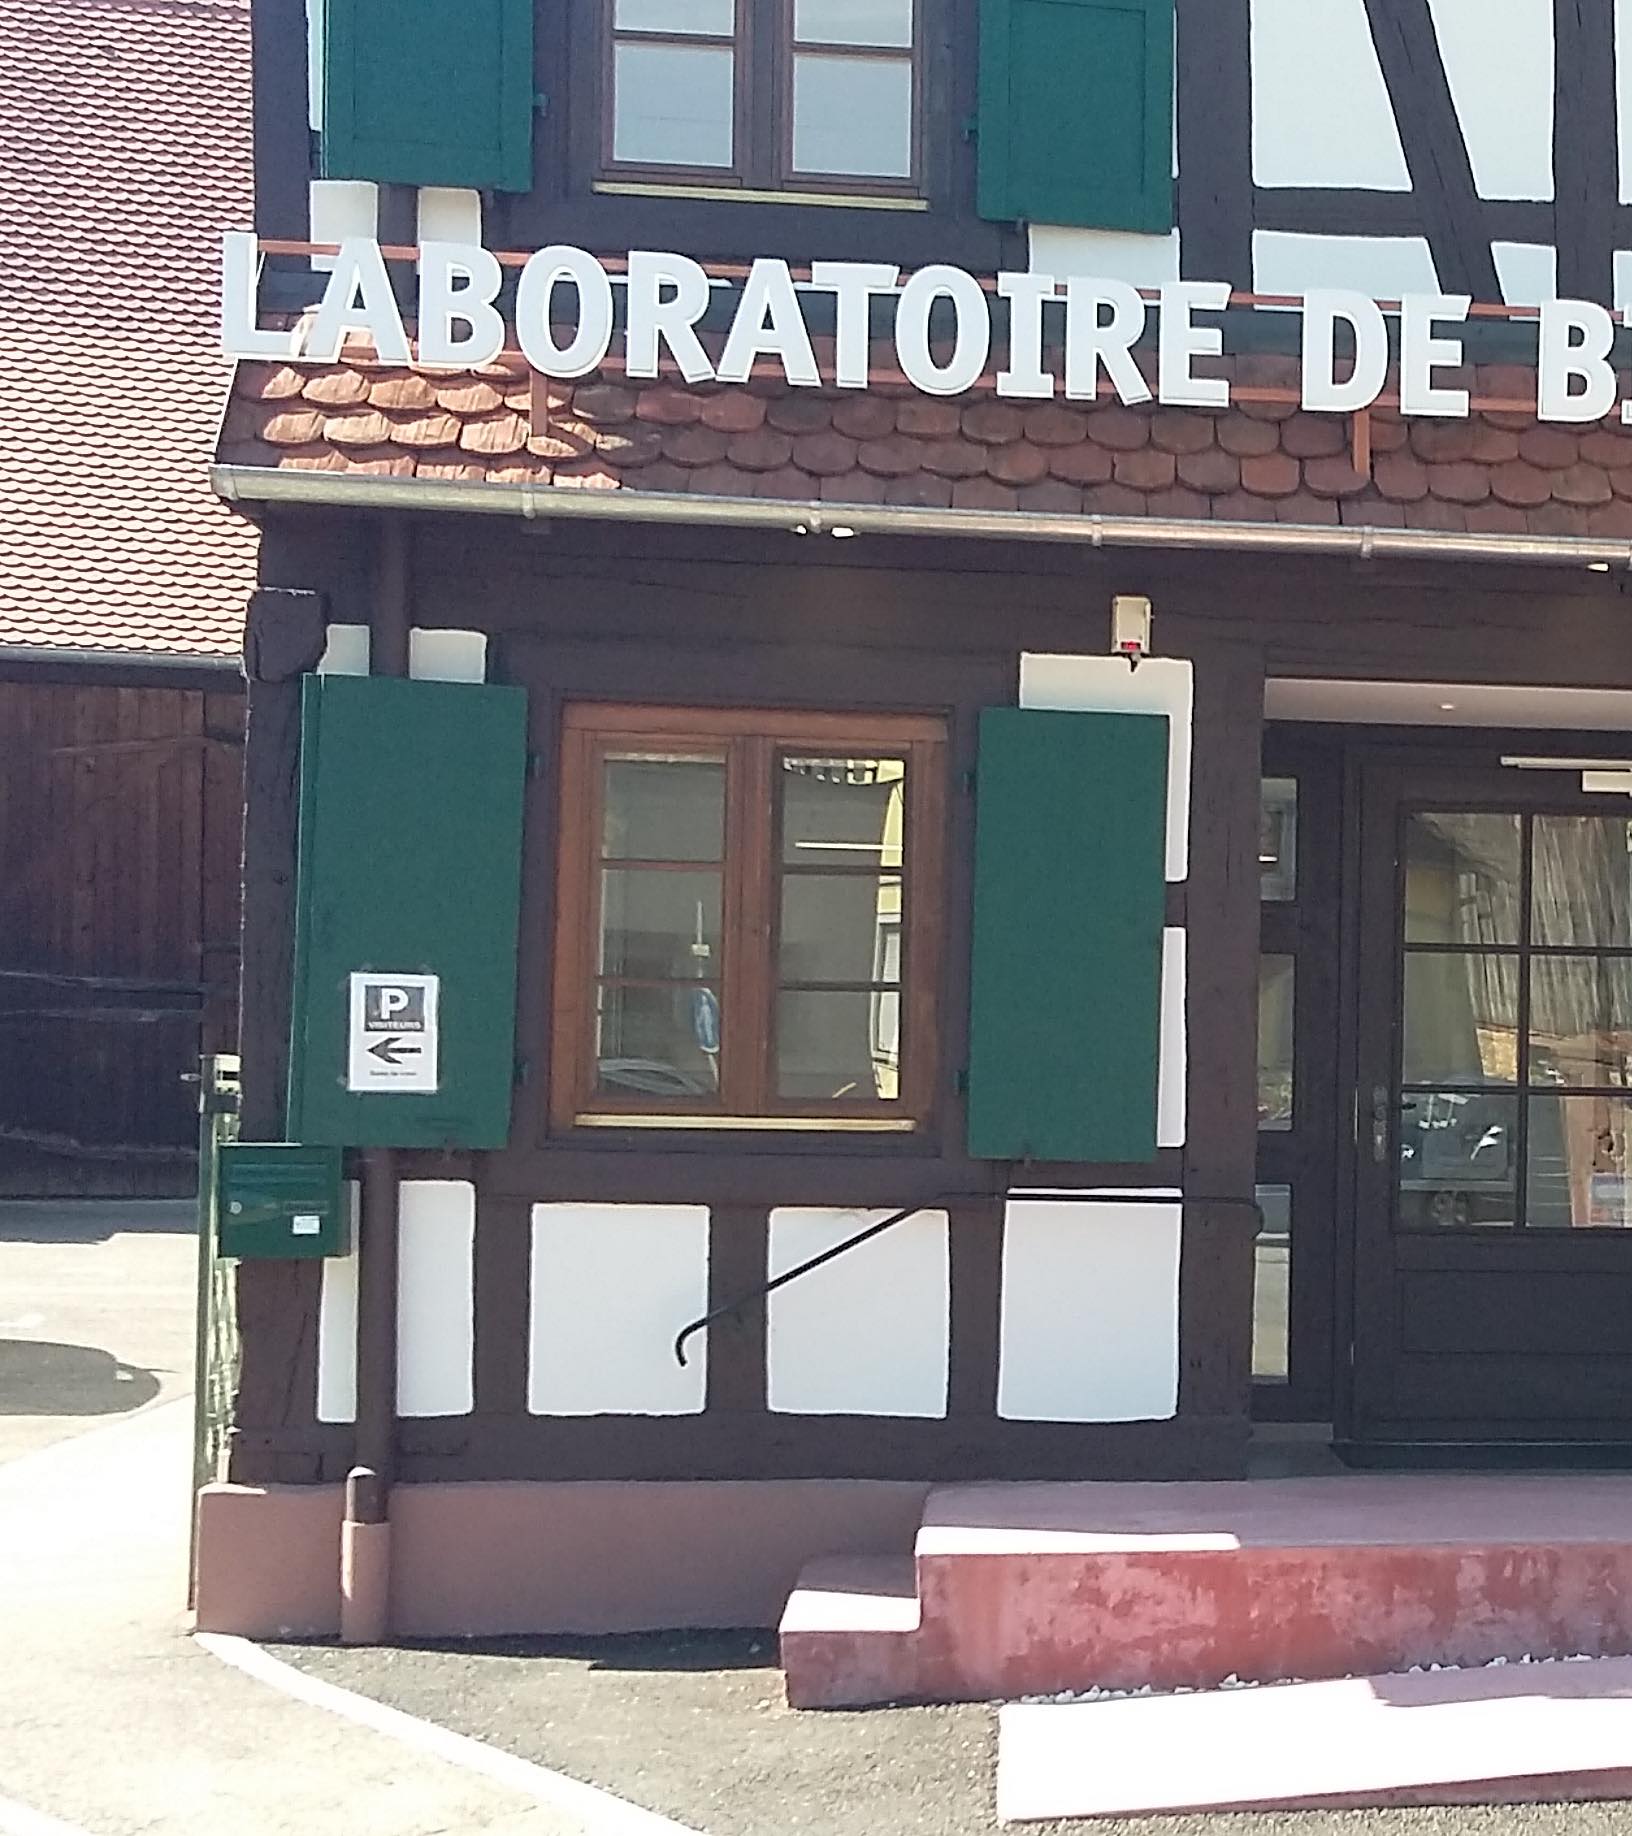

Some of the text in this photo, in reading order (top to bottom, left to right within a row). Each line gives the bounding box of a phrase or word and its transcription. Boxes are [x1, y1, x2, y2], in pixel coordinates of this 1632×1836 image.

[222, 231, 1232, 407] LABORATOIRE
[1301, 288, 1472, 418] DE
[380, 987, 409, 1020] P
